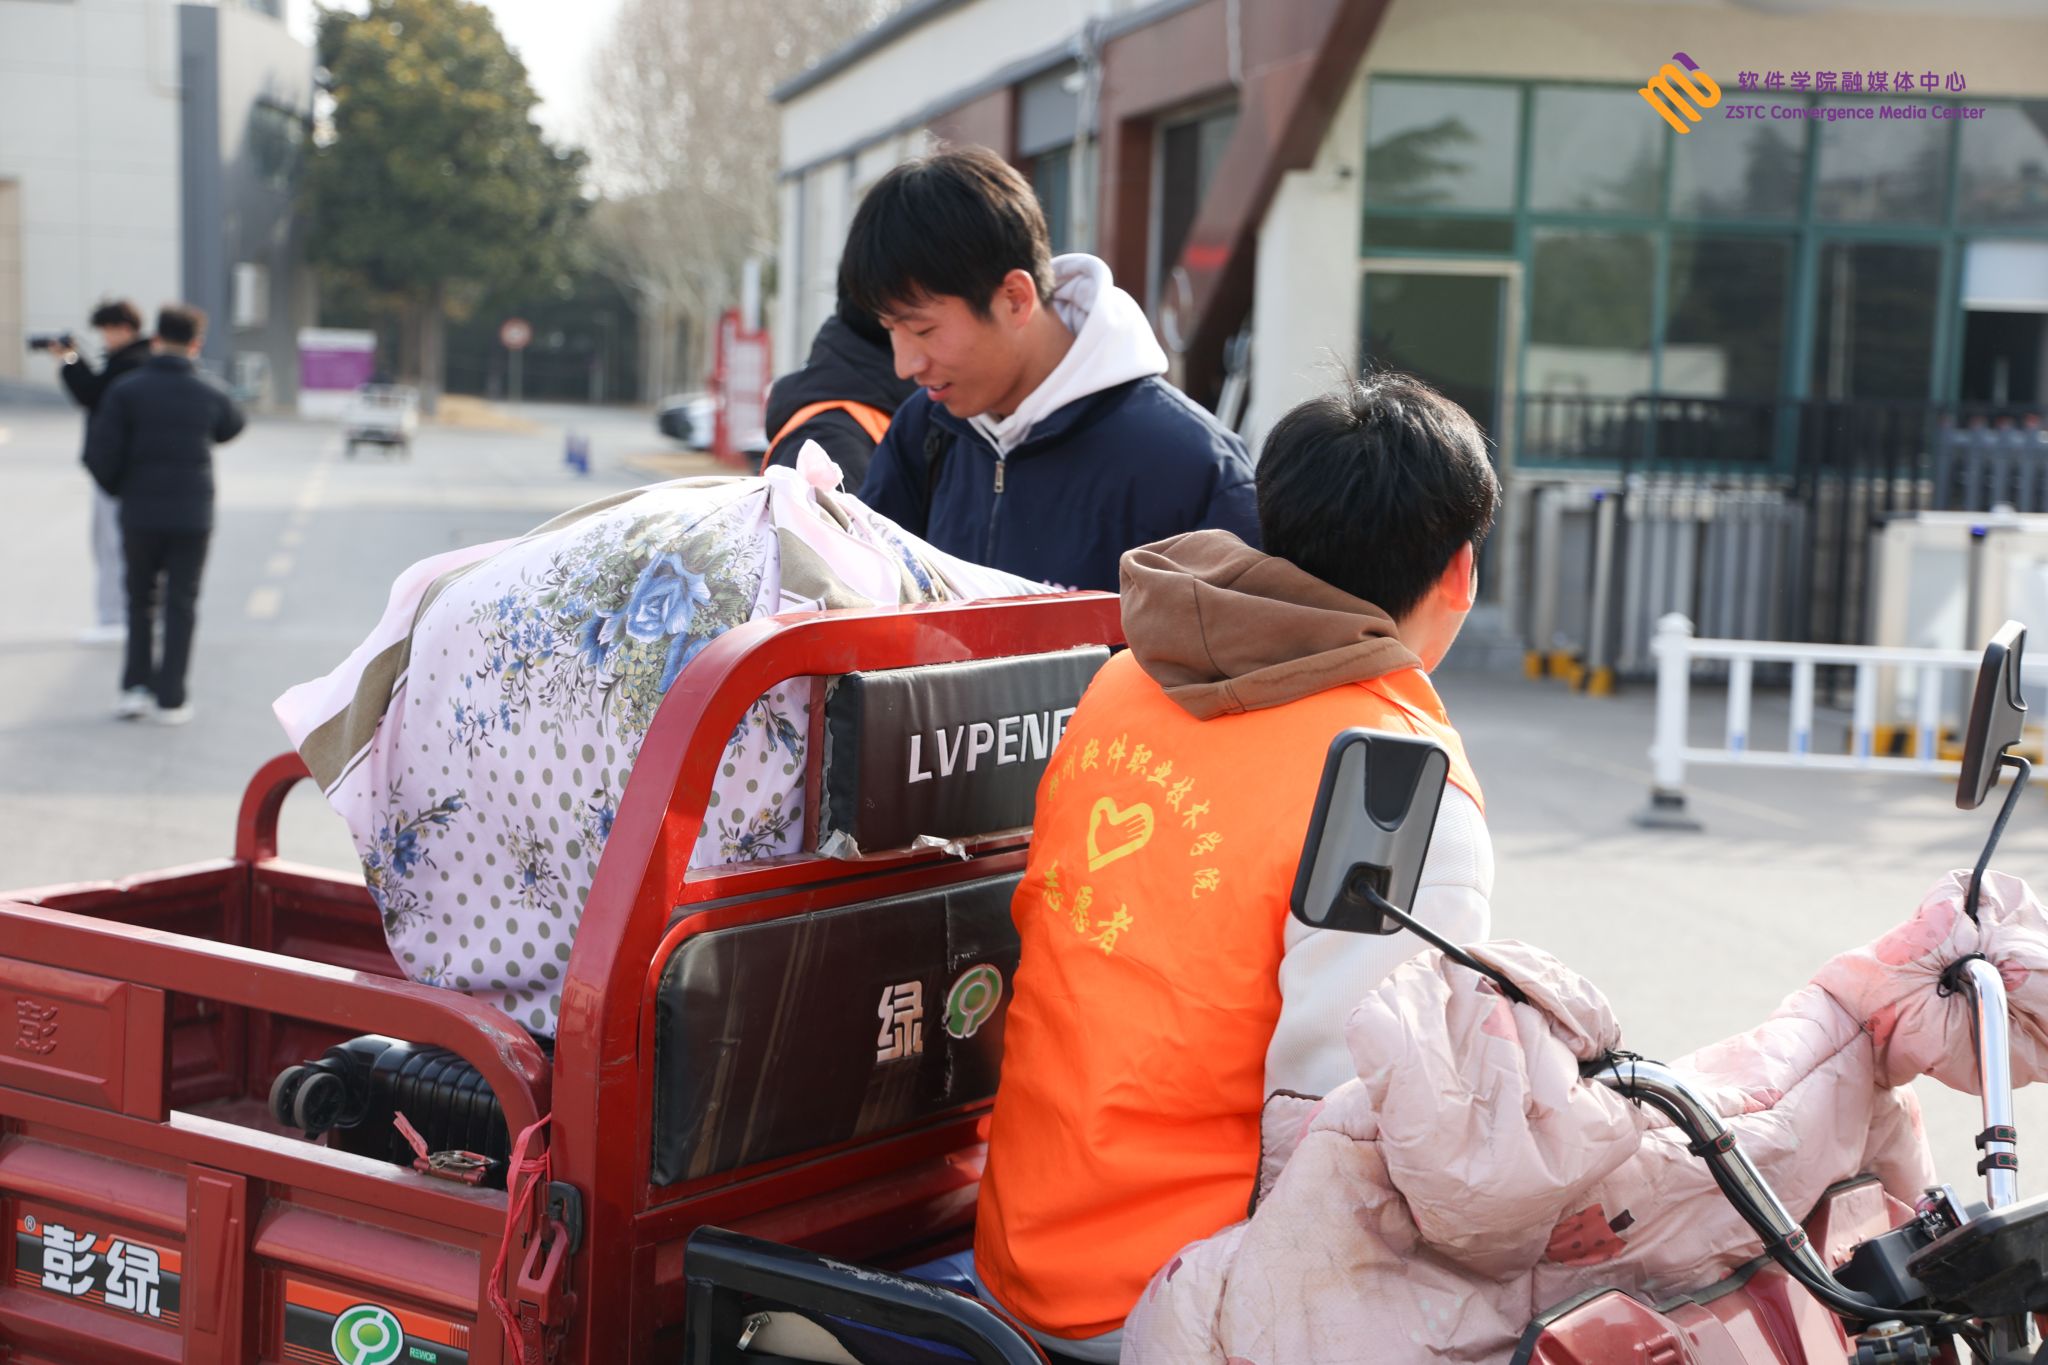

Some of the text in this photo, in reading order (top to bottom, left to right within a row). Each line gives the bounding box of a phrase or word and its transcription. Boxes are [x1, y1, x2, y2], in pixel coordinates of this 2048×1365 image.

[1042, 860, 1134, 955] 志愿者
[16, 1000, 58, 1055] 彭
[876, 980, 923, 1062] 绿
[41, 1224, 162, 1318] 彭绿
